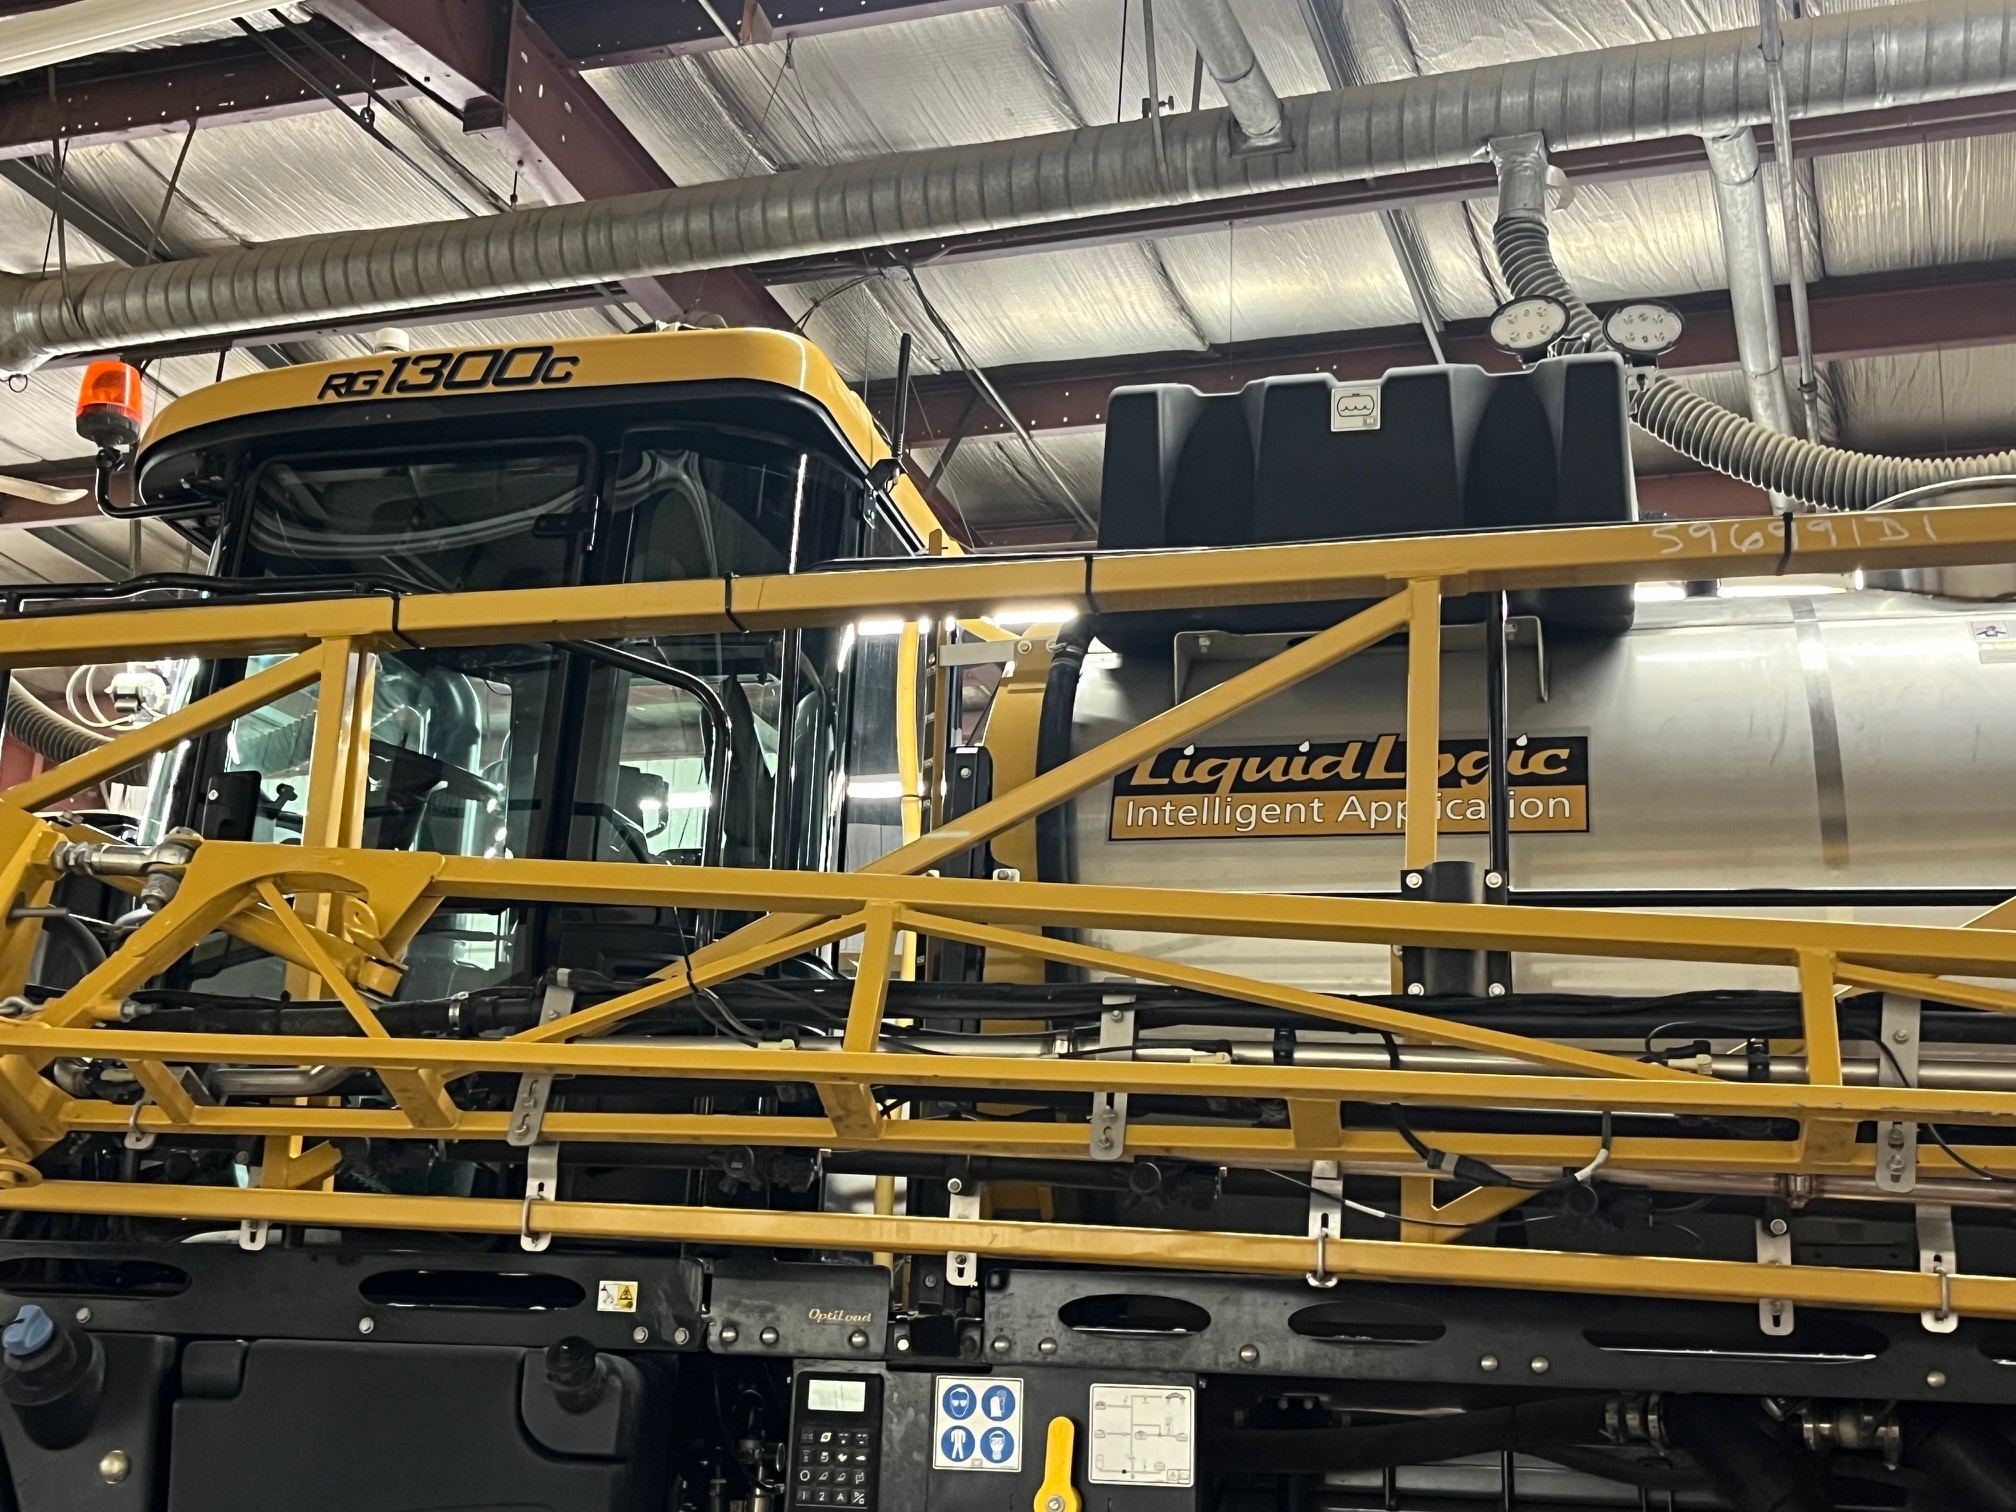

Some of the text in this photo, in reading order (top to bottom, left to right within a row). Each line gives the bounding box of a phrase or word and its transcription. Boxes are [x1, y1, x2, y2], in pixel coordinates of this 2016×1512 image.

[1125, 796, 1324, 832] Intelligent
[808, 1308, 872, 1323] OptiLoad
[819, 1492, 825, 1501] 2
